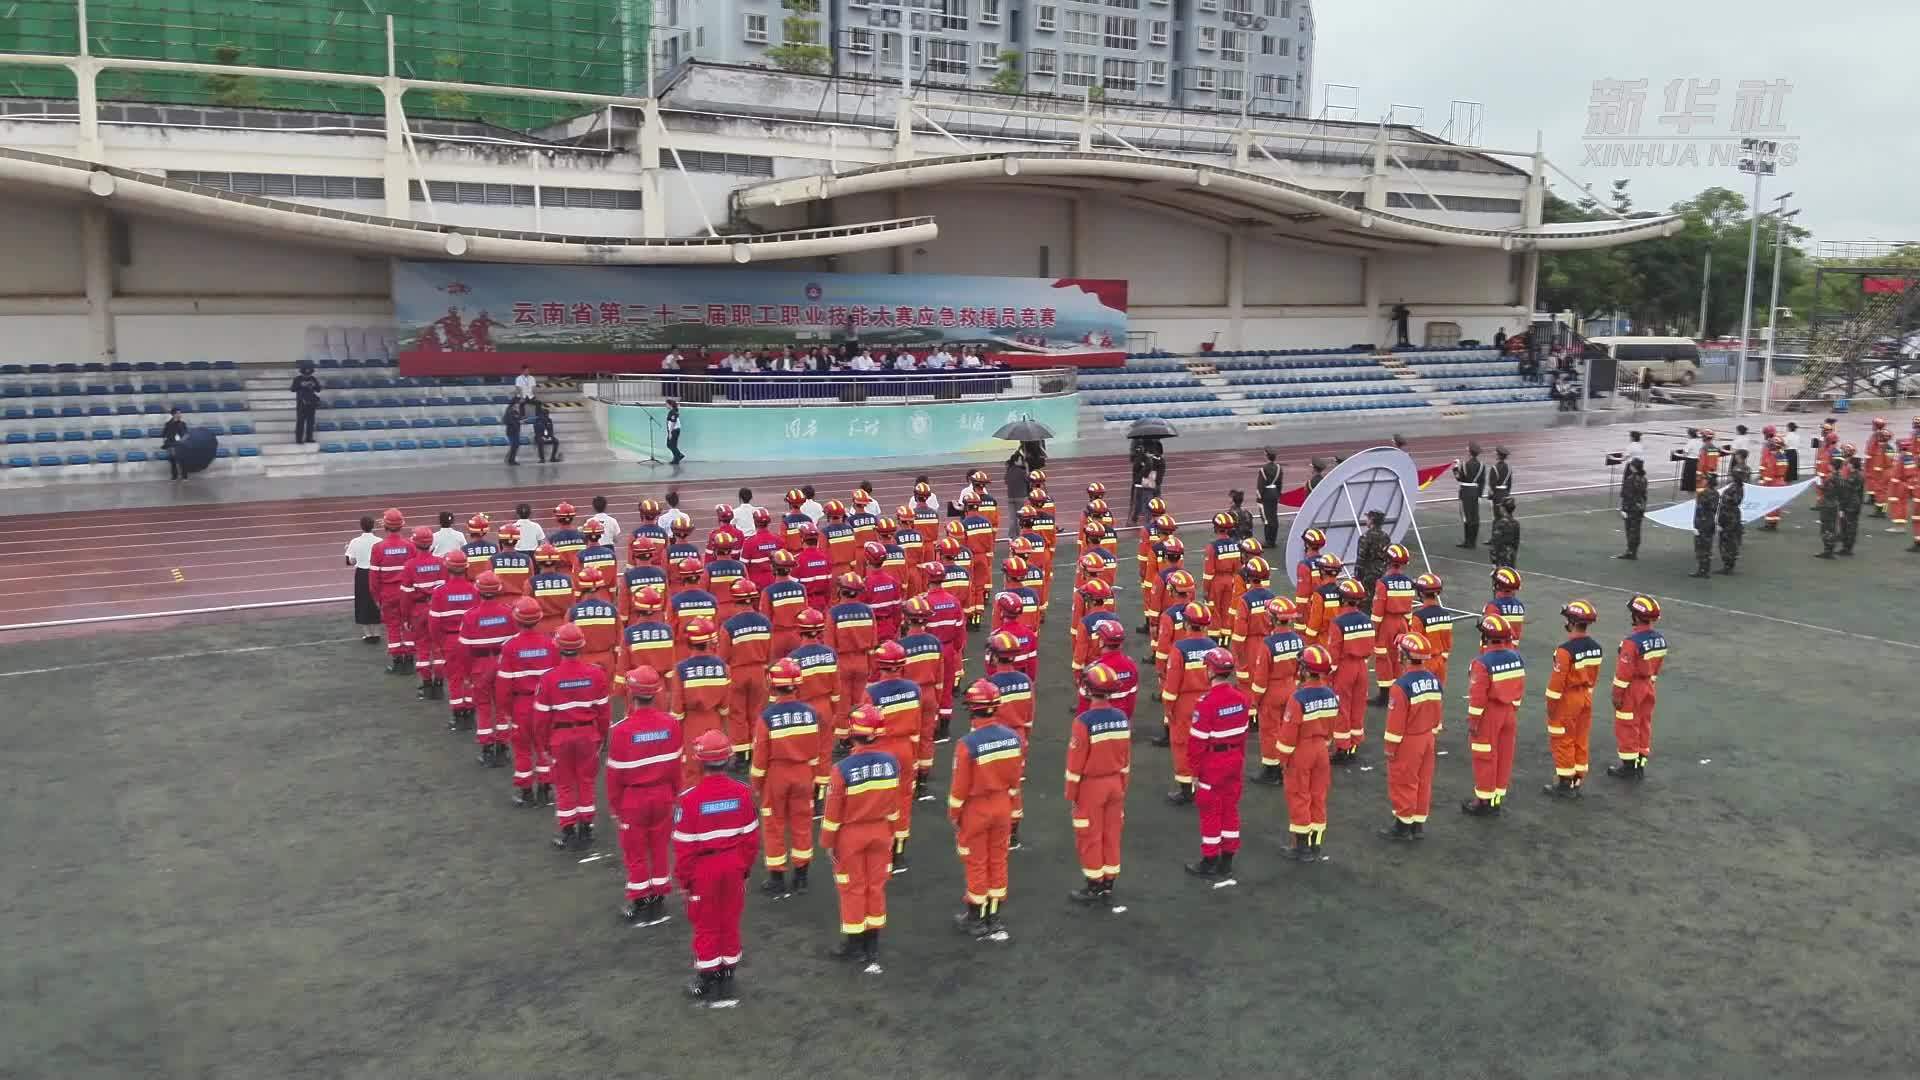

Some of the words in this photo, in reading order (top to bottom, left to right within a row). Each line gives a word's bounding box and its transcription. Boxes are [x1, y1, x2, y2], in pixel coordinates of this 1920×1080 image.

[512, 301, 1057, 329] 云南省第二十二届职工职业技能大赛应急救援员竞赛
